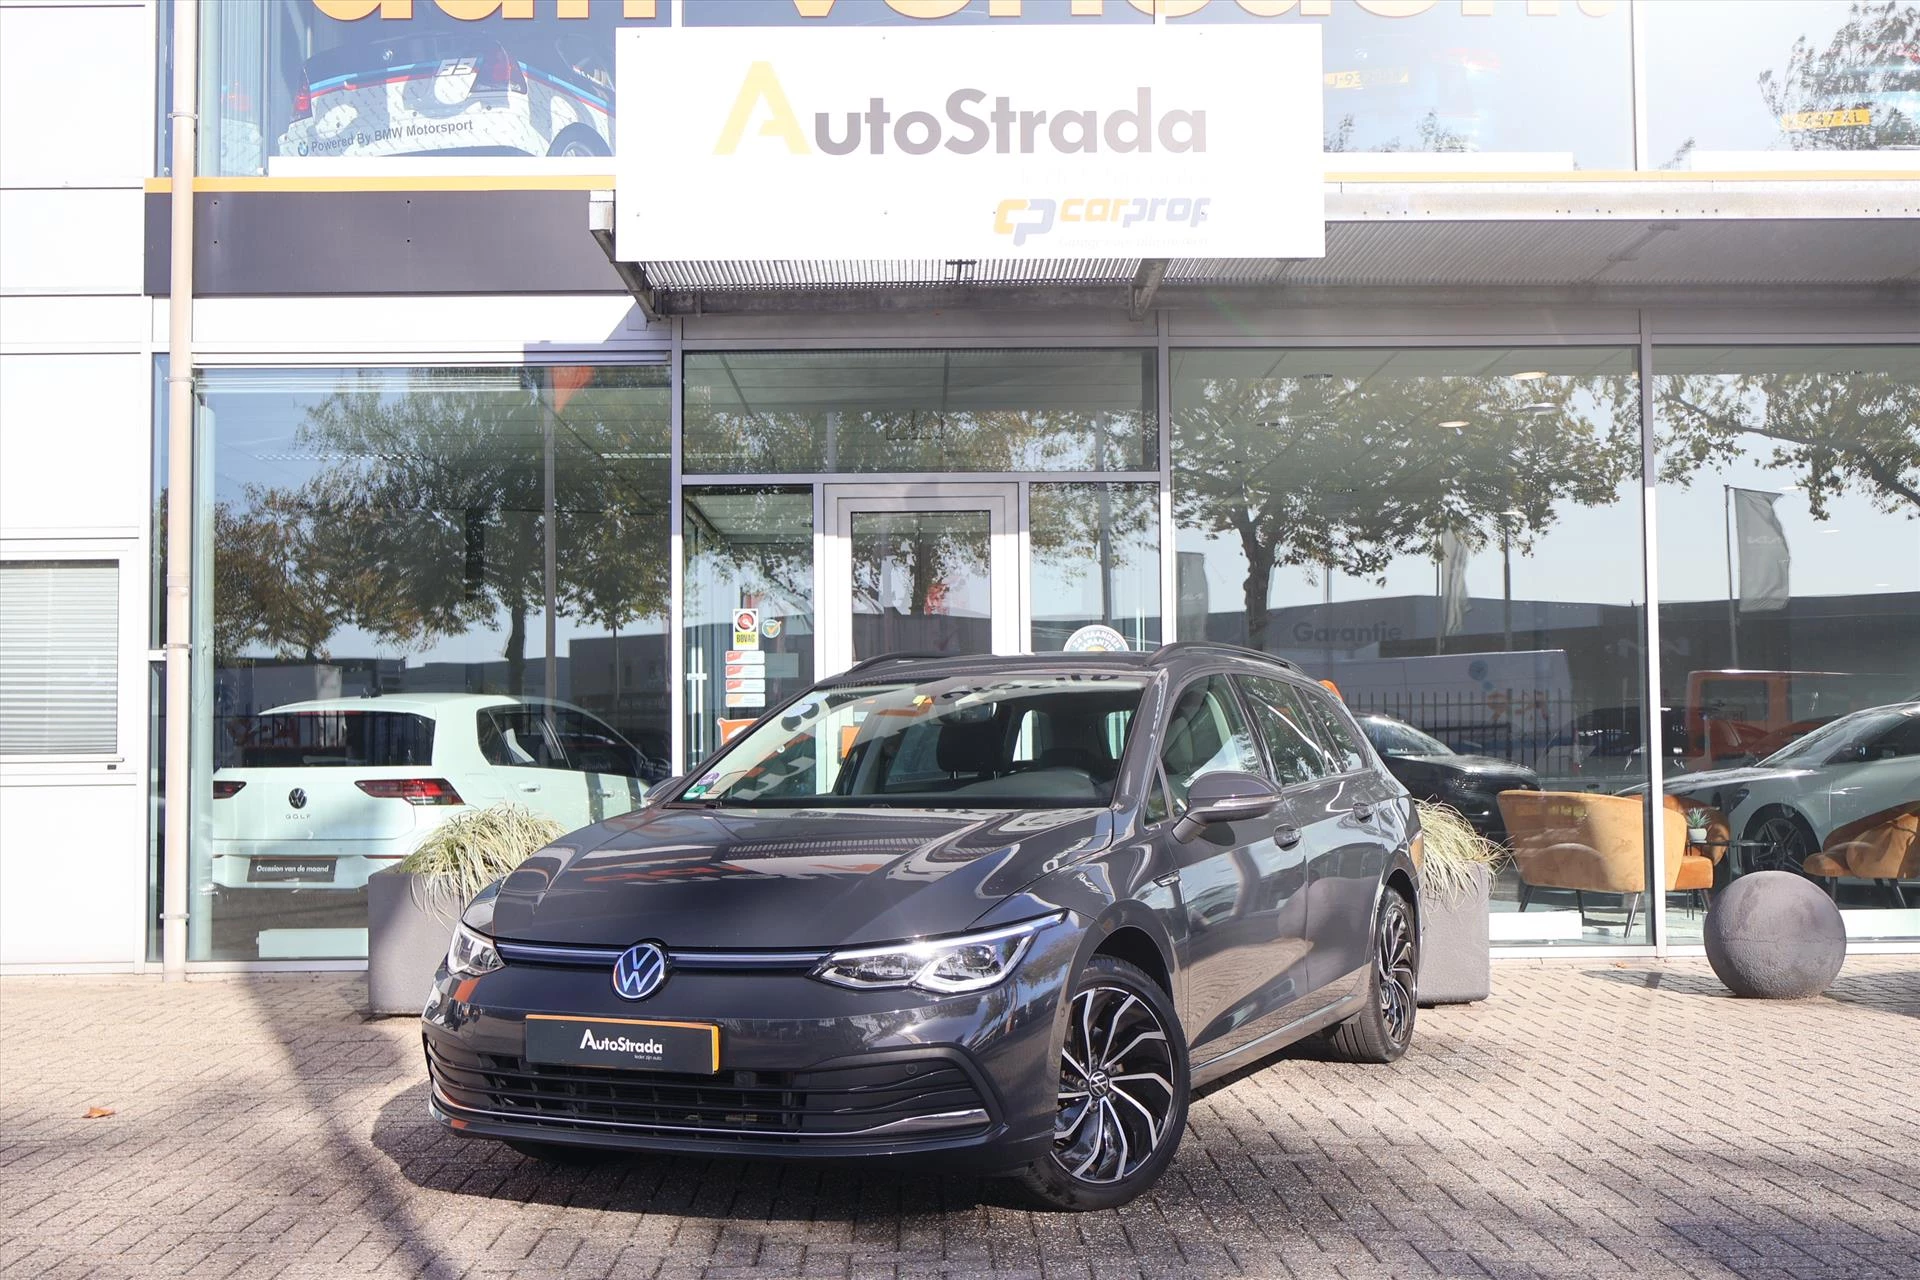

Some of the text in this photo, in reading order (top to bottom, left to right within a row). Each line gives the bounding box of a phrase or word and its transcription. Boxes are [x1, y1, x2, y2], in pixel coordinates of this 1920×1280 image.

[712, 61, 1207, 156] AutoStrada
[311, 119, 473, 152] Powered By BMW Motorsport
[736, 633, 756, 643] BOVAG
[1293, 621, 1402, 641] Garantie
[580, 1028, 663, 1054] AutoStrada
